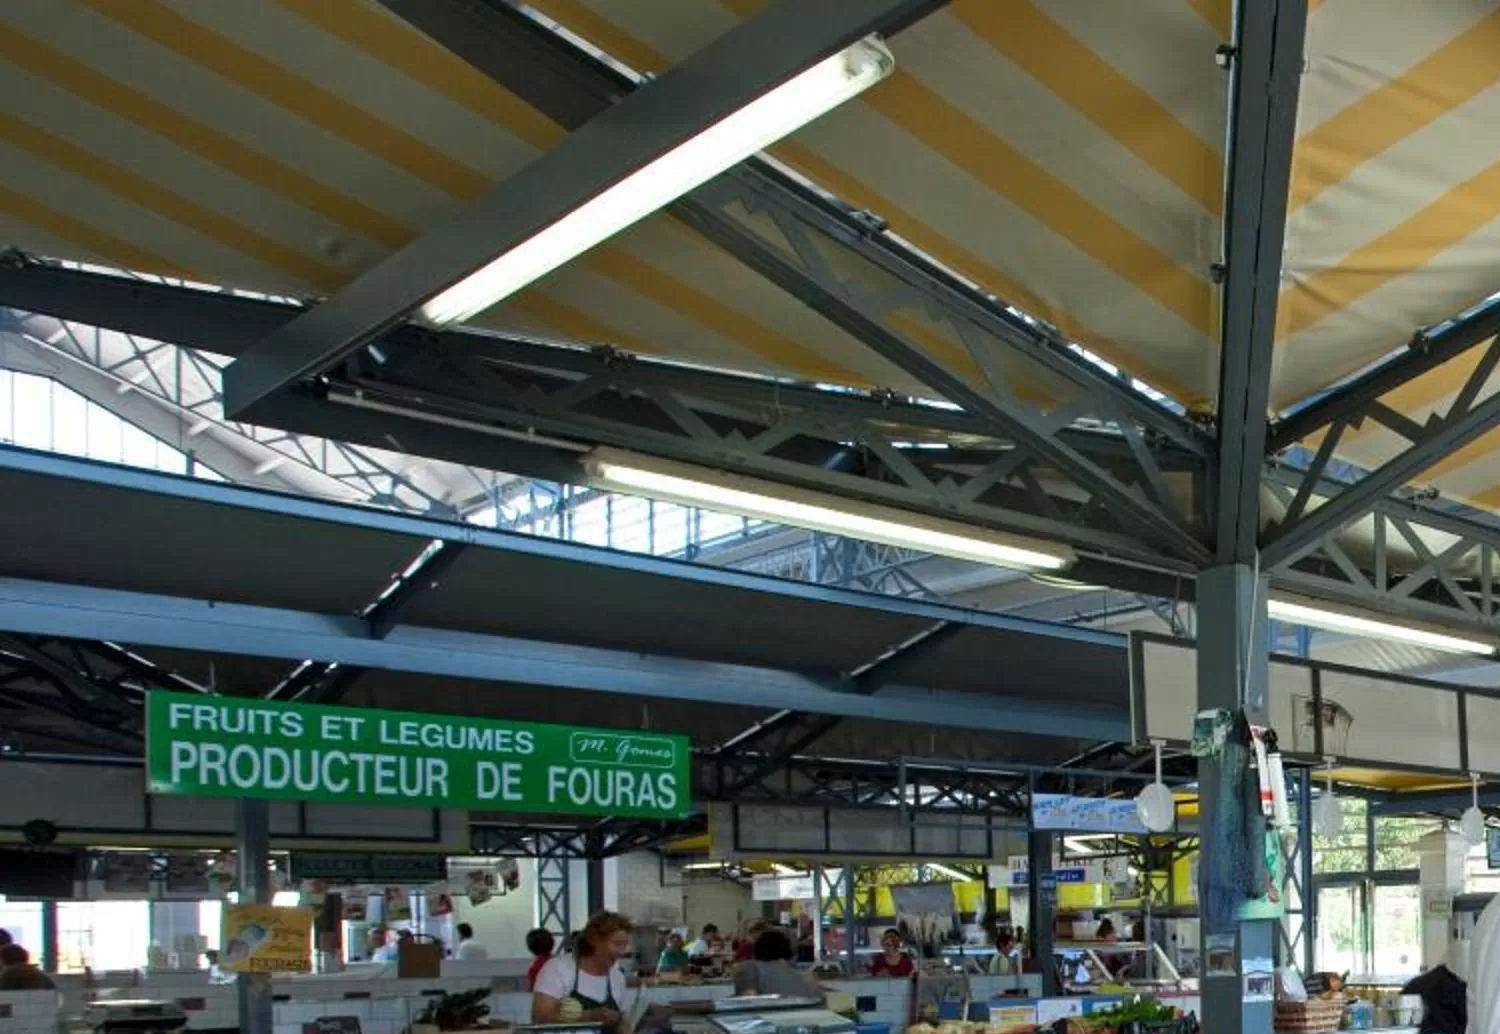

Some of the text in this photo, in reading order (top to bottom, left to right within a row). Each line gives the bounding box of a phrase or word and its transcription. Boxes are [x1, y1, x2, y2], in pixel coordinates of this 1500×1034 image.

[168, 702, 535, 755] FRUITS ET LEGUMES
[170, 740, 678, 810] PRODUCTEUR DE FOURAS
